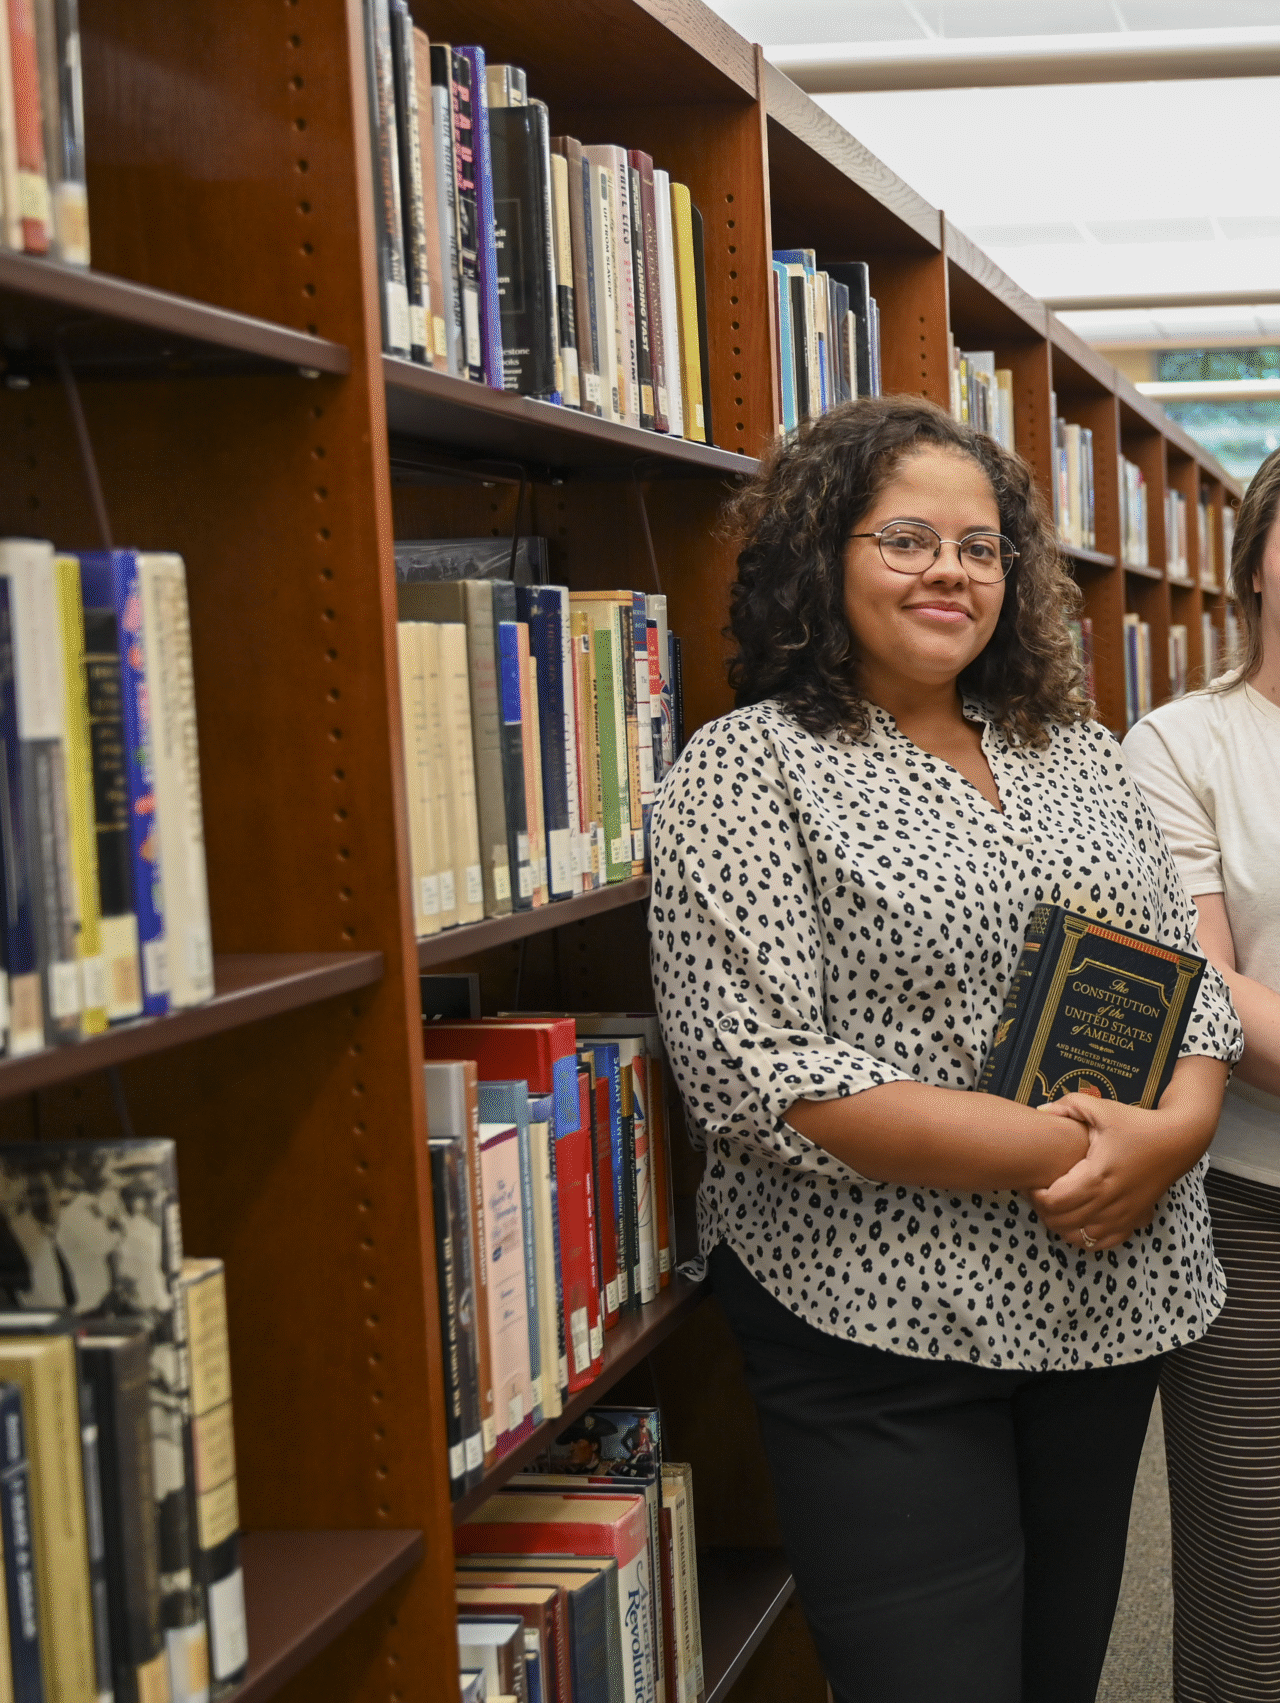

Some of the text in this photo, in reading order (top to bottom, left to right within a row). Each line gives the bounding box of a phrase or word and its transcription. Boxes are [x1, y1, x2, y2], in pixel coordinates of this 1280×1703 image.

[446, 143, 456, 208] ROBESON
[603, 206, 610, 222] UP
[619, 163, 630, 245] WHITE LIES
[604, 223, 612, 254] FROM
[605, 256, 613, 299] SLAVERY
[636, 249, 650, 353] STANDING FAST
[651, 298, 663, 365] WOODSO
[1072, 981, 1160, 1019] CONSTITUTION
[1109, 979, 1130, 994] The
[1064, 1005, 1153, 1043] UNITED STATES
[1097, 1004, 1126, 1020] of the
[1056, 1042, 1140, 1074] AND SELECTED WRITINGS OF
[1070, 1023, 1135, 1051] of AMERICA
[613, 1057, 621, 1104] SARAH
[1060, 1051, 1133, 1078] THE FOUNDING FATHERS
[470, 1105, 488, 1287] The American Revolution
[618, 1217, 626, 1245] UNITED
[443, 1237, 462, 1418] THE FRENCH AND INDIAN WAR
[655, 1535, 663, 1604] REVOLUTIONS
[679, 1525, 687, 1577] RADICALISM
[683, 1588, 691, 1633] AMERICAN
[625, 1588, 646, 1703] Revolutio
[637, 1561, 655, 1692] American
